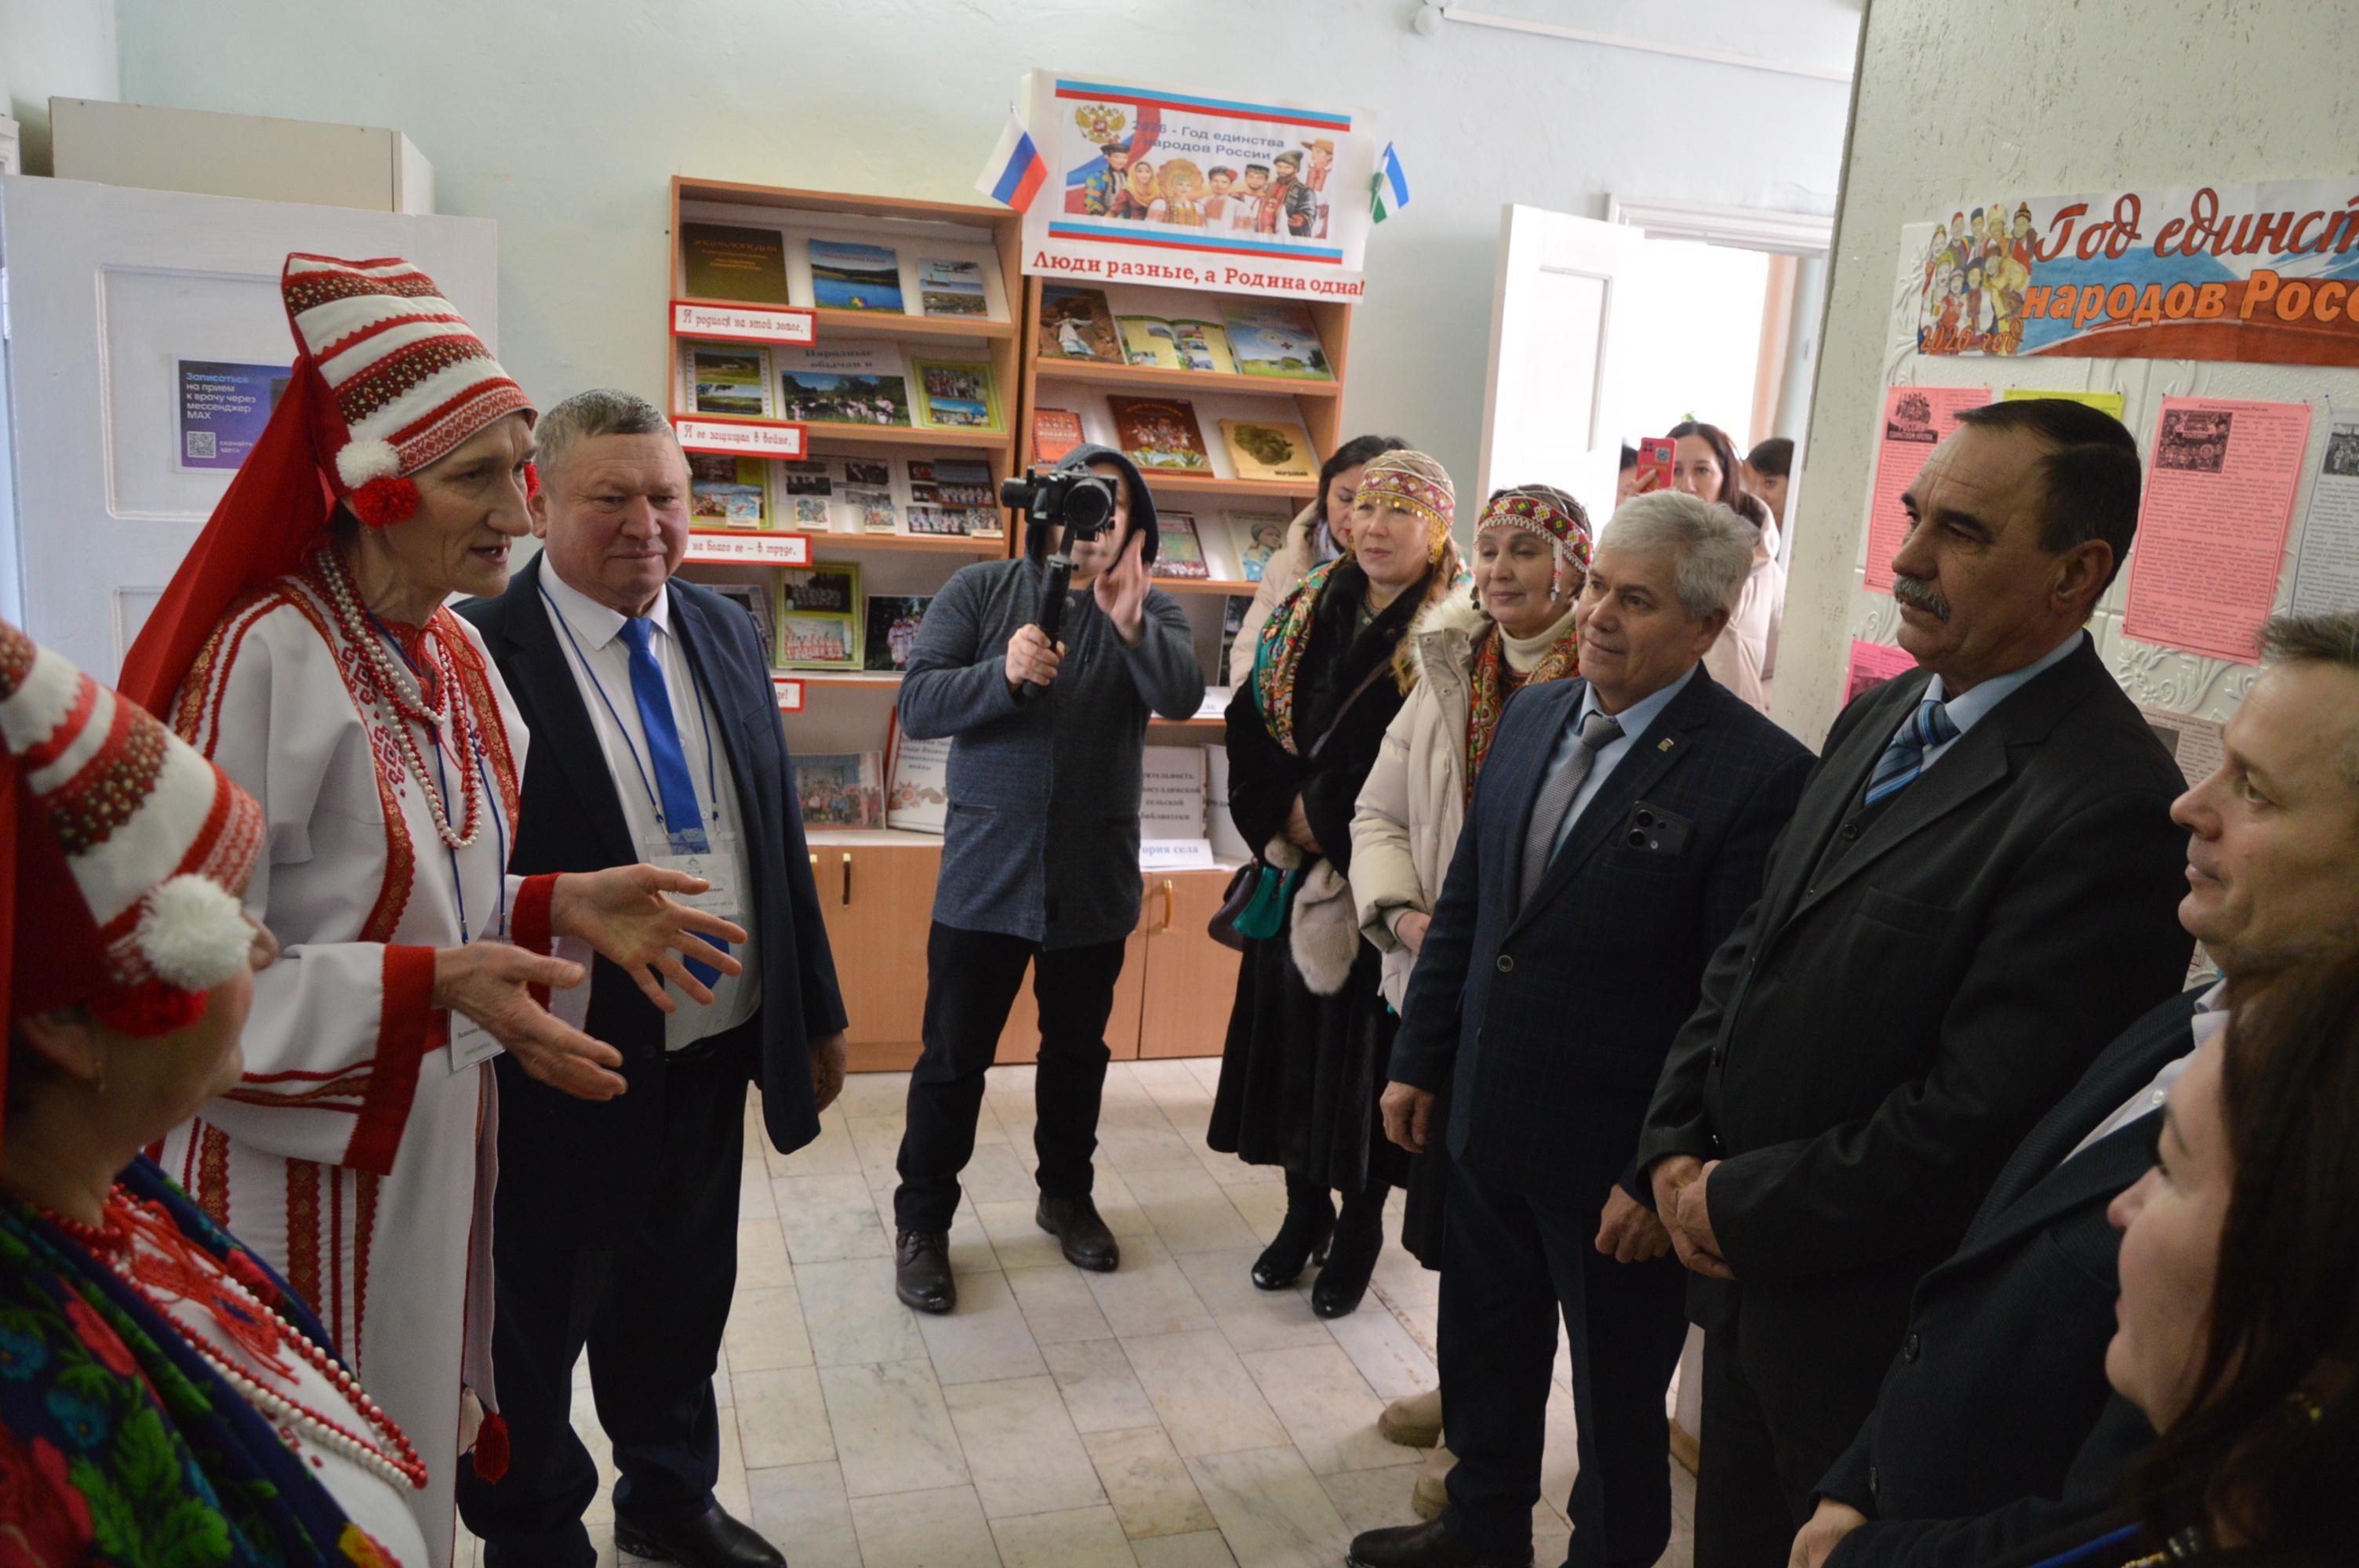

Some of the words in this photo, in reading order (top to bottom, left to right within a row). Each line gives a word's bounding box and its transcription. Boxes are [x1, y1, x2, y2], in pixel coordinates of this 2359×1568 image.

[1132, 120, 1167, 133] 2026
[1182, 126, 1209, 140] Год
[1213, 132, 1285, 147] единства
[1144, 138, 1211, 153] народов
[1216, 144, 1270, 159] России
[2034, 193, 2142, 262] Год
[1032, 251, 1101, 273] Люди
[1106, 260, 1200, 285] разные,
[1205, 270, 1216, 283] а
[1224, 267, 1307, 290] Родина
[1310, 279, 1365, 296] одна!
[2022, 281, 2229, 329] народов
[683, 308, 692, 323] Я
[696, 315, 731, 328] родился
[735, 319, 745, 328] на
[749, 318, 772, 329] этой
[776, 322, 804, 334] земле,
[1920, 324, 1975, 351] 2026
[1981, 318, 2023, 352] год
[186, 372, 249, 383] Записаться
[195, 394, 224, 403] врачу
[226, 394, 256, 404] через
[202, 384, 235, 394] прием
[187, 402, 252, 414] мессенджер
[684, 424, 693, 439] Я
[697, 430, 706, 439] ее
[710, 432, 750, 445] защищал
[754, 431, 759, 443] в
[763, 432, 792, 446] войне,
[692, 542, 703, 551] на
[707, 540, 732, 553] благо
[735, 544, 743, 553] ее
[758, 541, 763, 553] в
[1142, 847, 1170, 856] ория
